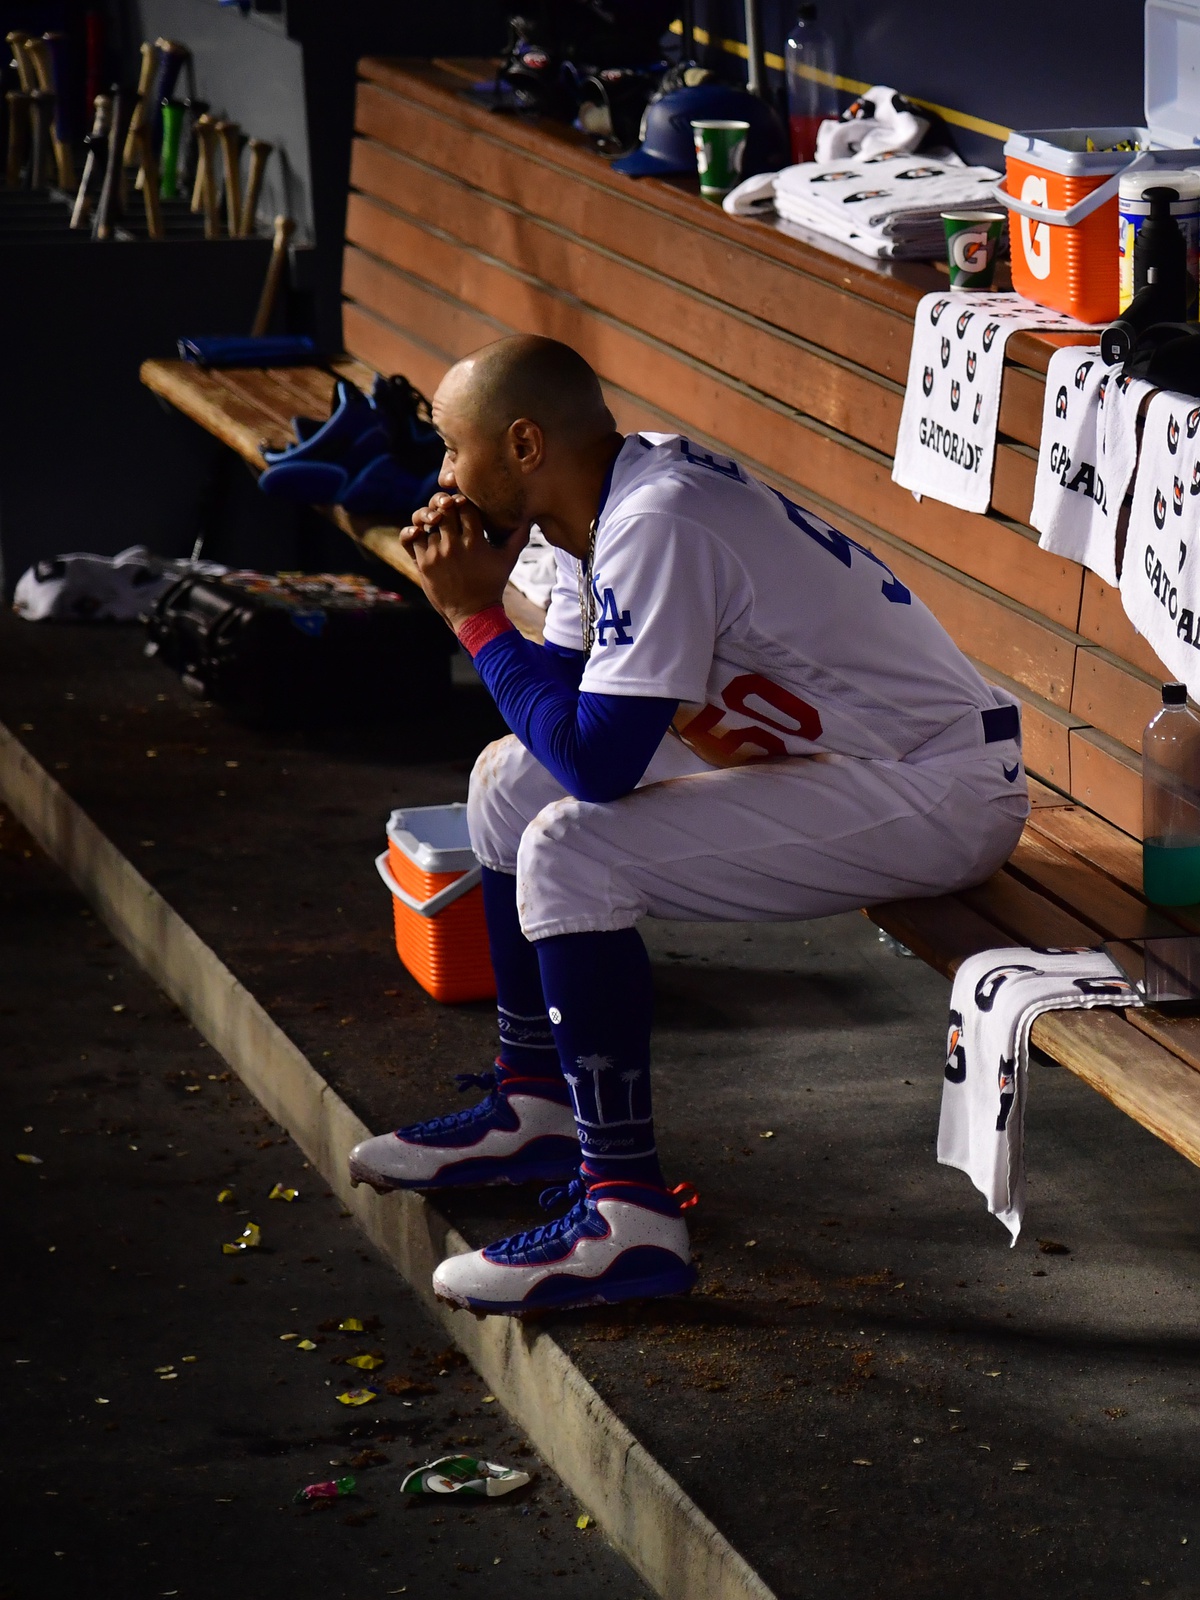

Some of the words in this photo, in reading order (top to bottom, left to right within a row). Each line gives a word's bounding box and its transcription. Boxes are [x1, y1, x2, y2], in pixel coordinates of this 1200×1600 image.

[953, 232, 988, 273] G
[1020, 174, 1050, 280] G
[592, 573, 634, 646] LA
[680, 673, 824, 767] 50
[577, 1128, 636, 1152] Dodgers
